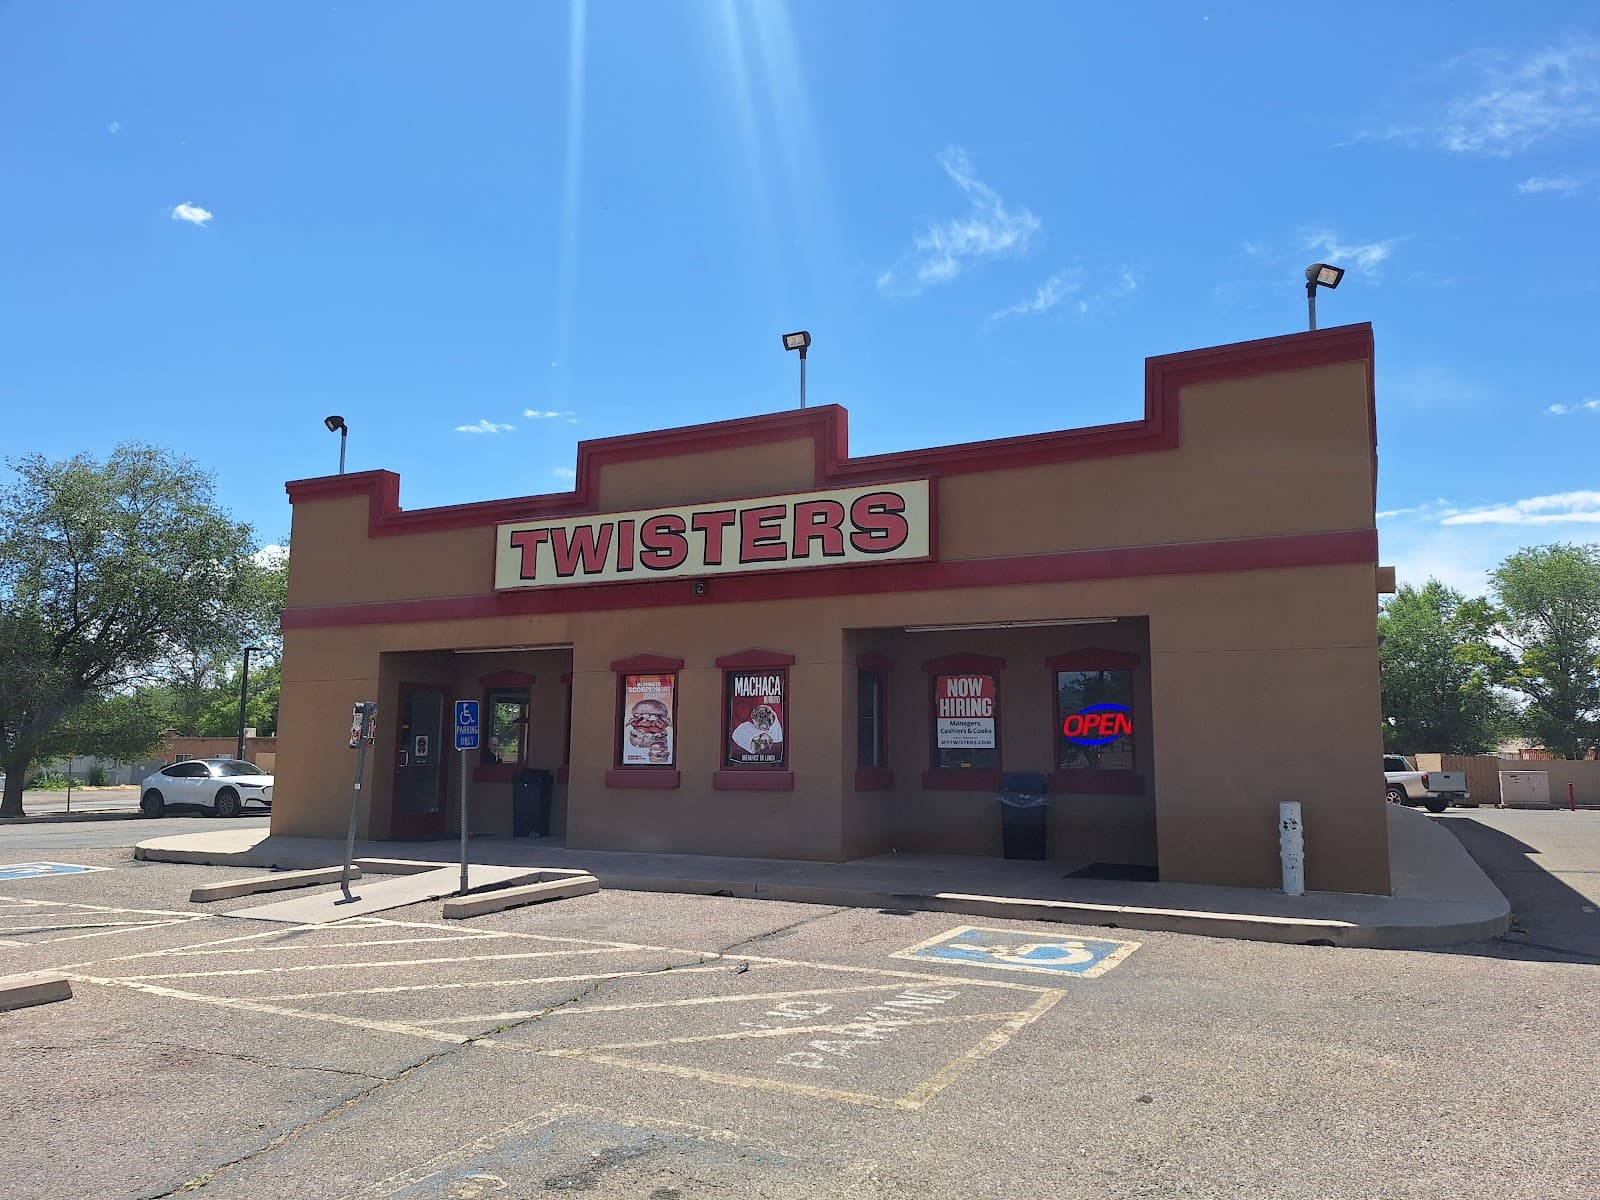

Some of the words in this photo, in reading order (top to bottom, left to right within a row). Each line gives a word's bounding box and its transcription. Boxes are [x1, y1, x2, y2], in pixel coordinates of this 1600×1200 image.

[510, 491, 908, 581] TWISTERS
[734, 676, 781, 696] MACHACA
[947, 678, 983, 697] NOW
[939, 697, 992, 717] HIRING
[456, 725, 478, 735] PARKING
[1063, 713, 1132, 737] OPEN
[461, 735, 474, 745] ONLY
